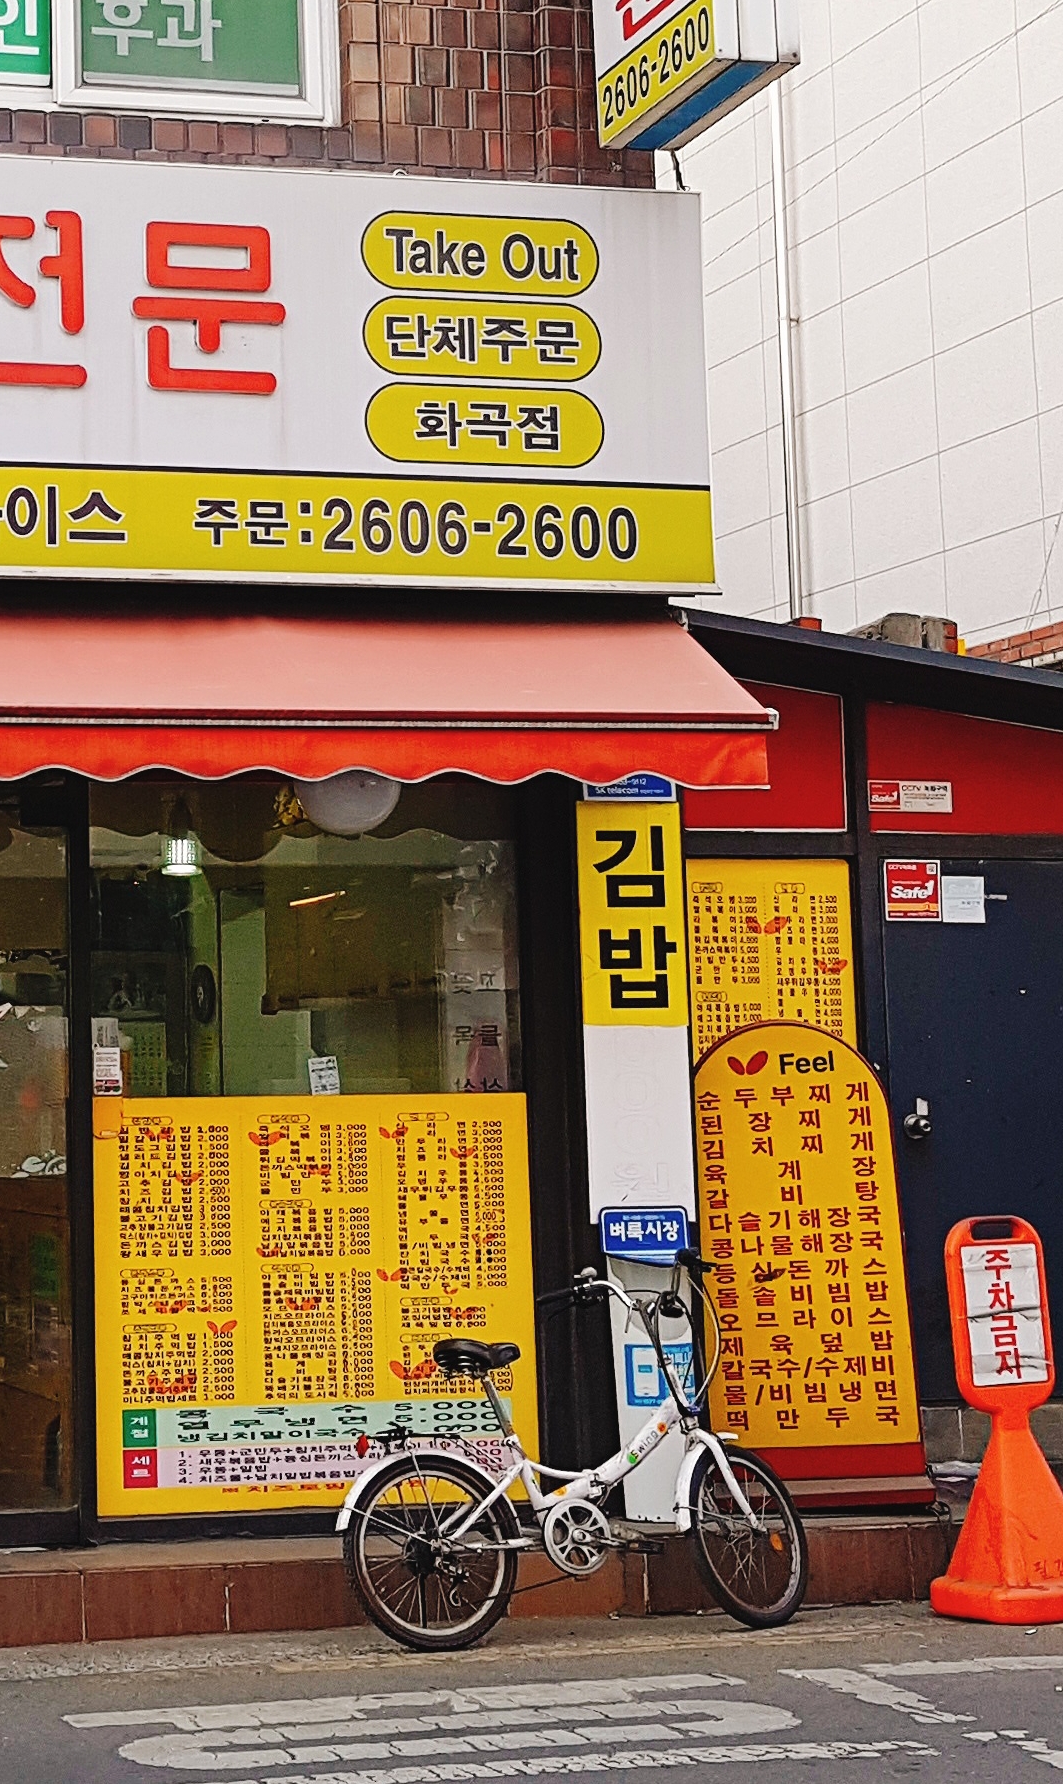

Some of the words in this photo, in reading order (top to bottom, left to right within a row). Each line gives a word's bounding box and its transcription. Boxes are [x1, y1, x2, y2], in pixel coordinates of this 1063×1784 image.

[602, 5, 710, 129] 2606-2600
[385, 228, 485, 276] Take
[501, 233, 580, 281] Out
[384, 315, 581, 363] 단체주문
[414, 401, 562, 453] 화곡점
[593, 825, 678, 1010] 김밥
[778, 1051, 835, 1075] Feel
[609, 1221, 680, 1242] 벼룩시장
[984, 1249, 1023, 1380] 주차금지
